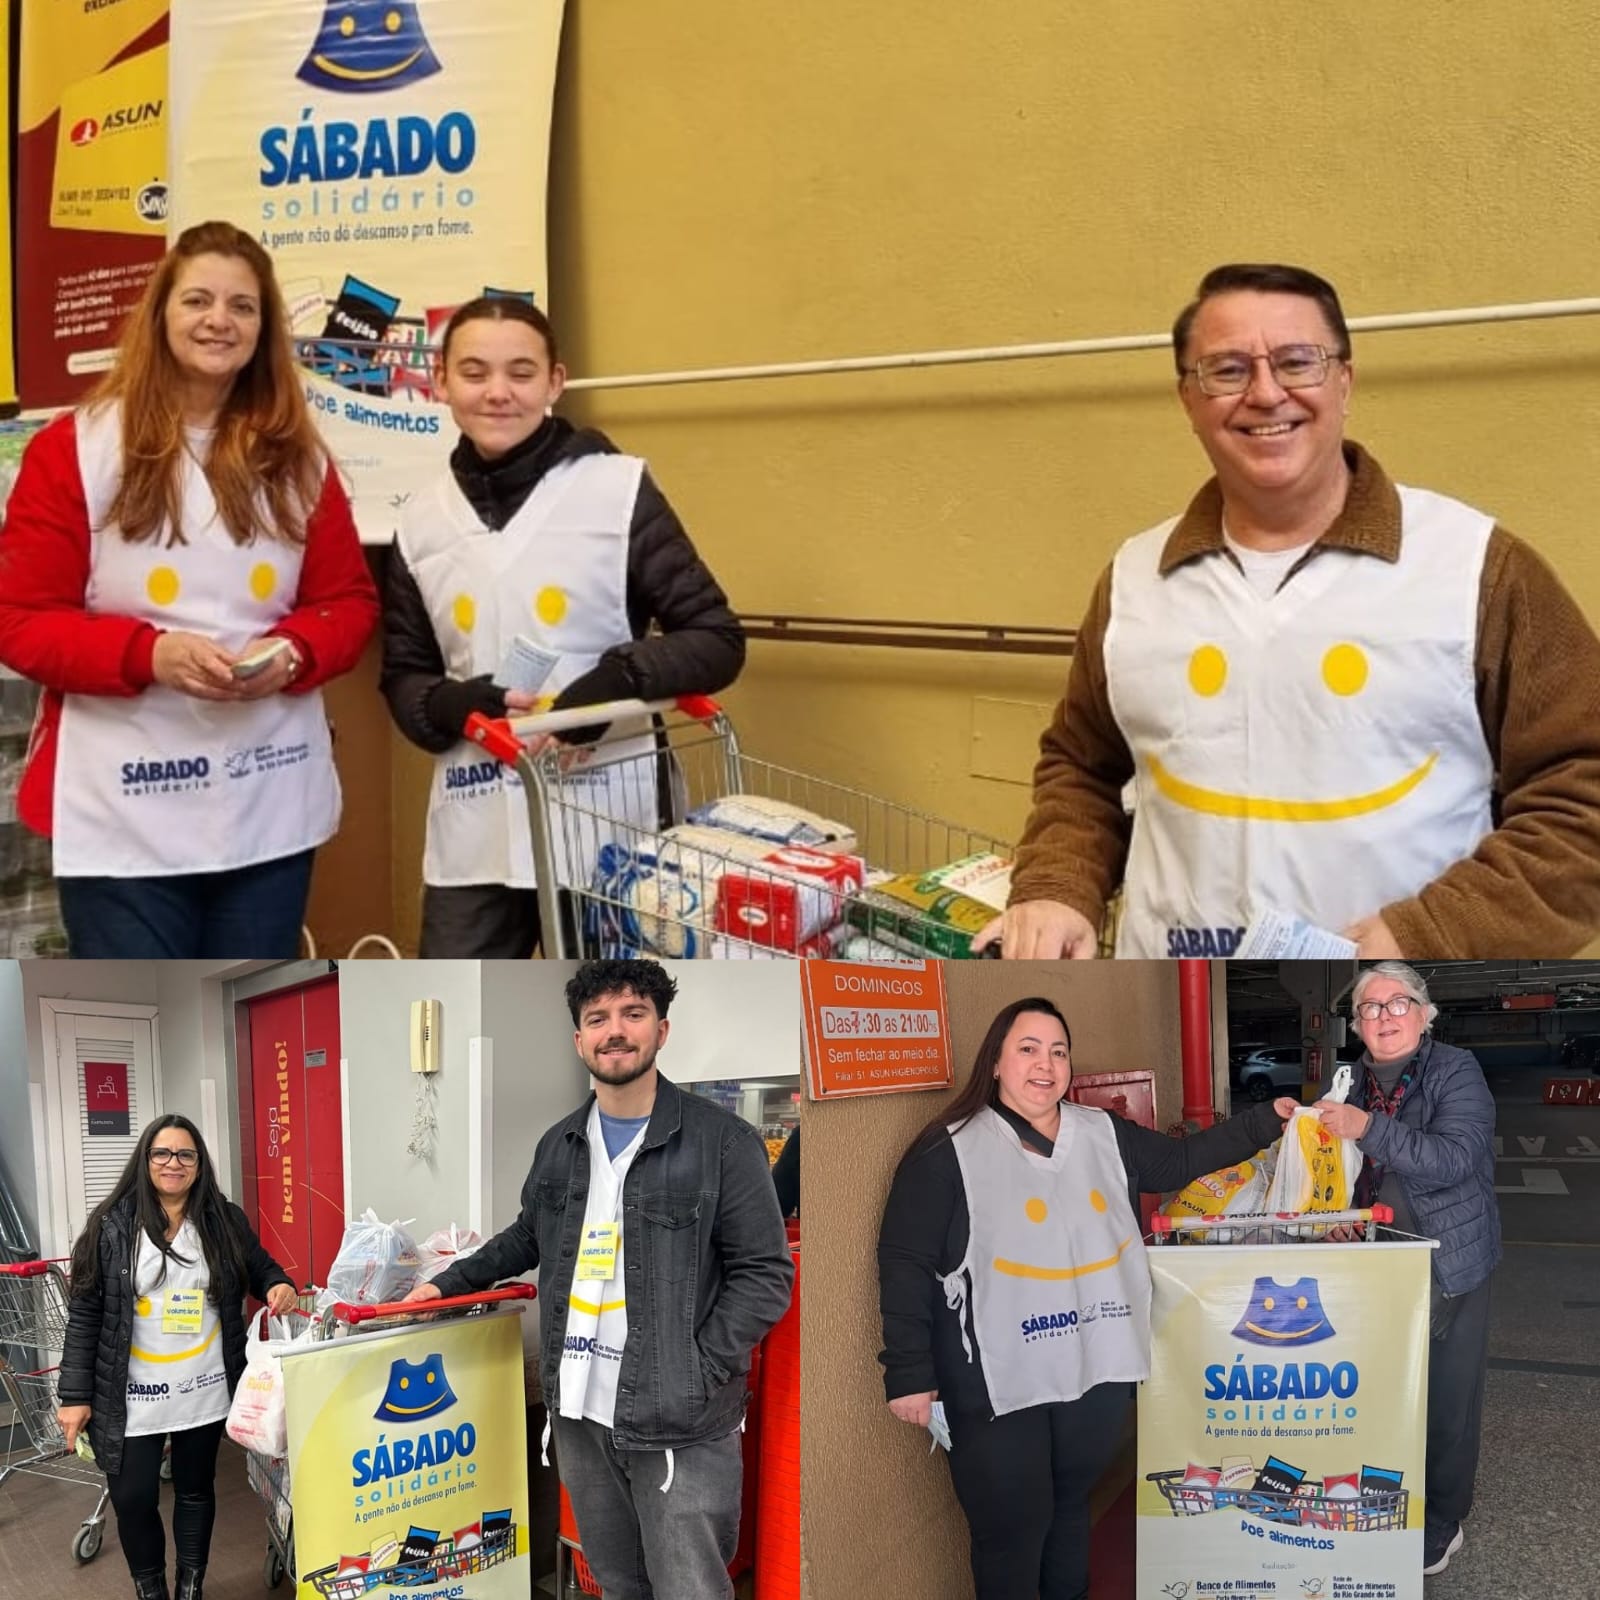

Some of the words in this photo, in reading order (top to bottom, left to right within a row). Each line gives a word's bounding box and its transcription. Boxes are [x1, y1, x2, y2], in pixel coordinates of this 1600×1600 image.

[102, 100, 162, 131] ASUN
[260, 108, 475, 187] SÁBADO
[262, 182, 474, 219] solidário
[260, 230, 268, 245] A
[272, 232, 304, 249] gente
[309, 227, 330, 242] não
[335, 222, 350, 242] dá
[353, 221, 409, 240] descanso
[411, 223, 433, 241] pra
[438, 217, 474, 237] fome.
[335, 311, 378, 340] feijão
[344, 402, 440, 433] alimentos
[122, 756, 210, 784] SÁBADO
[835, 975, 923, 996] DOMINGOS
[885, 1018, 898, 1033] as
[828, 1048, 853, 1063] Sem
[856, 1047, 886, 1062] fechar
[889, 1050, 900, 1060] ao
[903, 1047, 923, 1060] meio
[268, 1107, 280, 1158] Seja
[282, 1155, 294, 1223] bem
[1181, 1200, 1207, 1215] ASUN
[1304, 1208, 1342, 1216] ASUN
[1021, 1310, 1078, 1336] SÁBADO
[128, 1381, 169, 1395] SÁBADO
[1205, 1354, 1359, 1400] SÁBADO
[1206, 1403, 1357, 1421] solidário
[1206, 1425, 1212, 1435] A
[1214, 1427, 1239, 1438] gente
[1241, 1426, 1258, 1437] não
[1261, 1426, 1272, 1437] dá
[1274, 1425, 1312, 1437] descanso
[1315, 1427, 1330, 1438] pra
[1333, 1424, 1357, 1435] fome.
[352, 1422, 476, 1487] SÁBADO
[355, 1463, 476, 1507] solidário
[1262, 1475, 1292, 1493] feijão
[355, 1513, 361, 1523] A
[362, 1507, 384, 1523] gente
[386, 1503, 400, 1514] não
[401, 1498, 411, 1509] dá
[413, 1489, 443, 1506] descanso
[445, 1486, 457, 1499] pra
[458, 1480, 477, 1492] fome.
[405, 1546, 429, 1557] feijão
[1269, 1530, 1335, 1551] alimentos
[1196, 1581, 1221, 1590] Banco
[1223, 1581, 1233, 1590] de
[1235, 1579, 1276, 1590] Alimentos
[1333, 1582, 1354, 1590] Bancos
[1364, 1582, 1395, 1590] Alimentos
